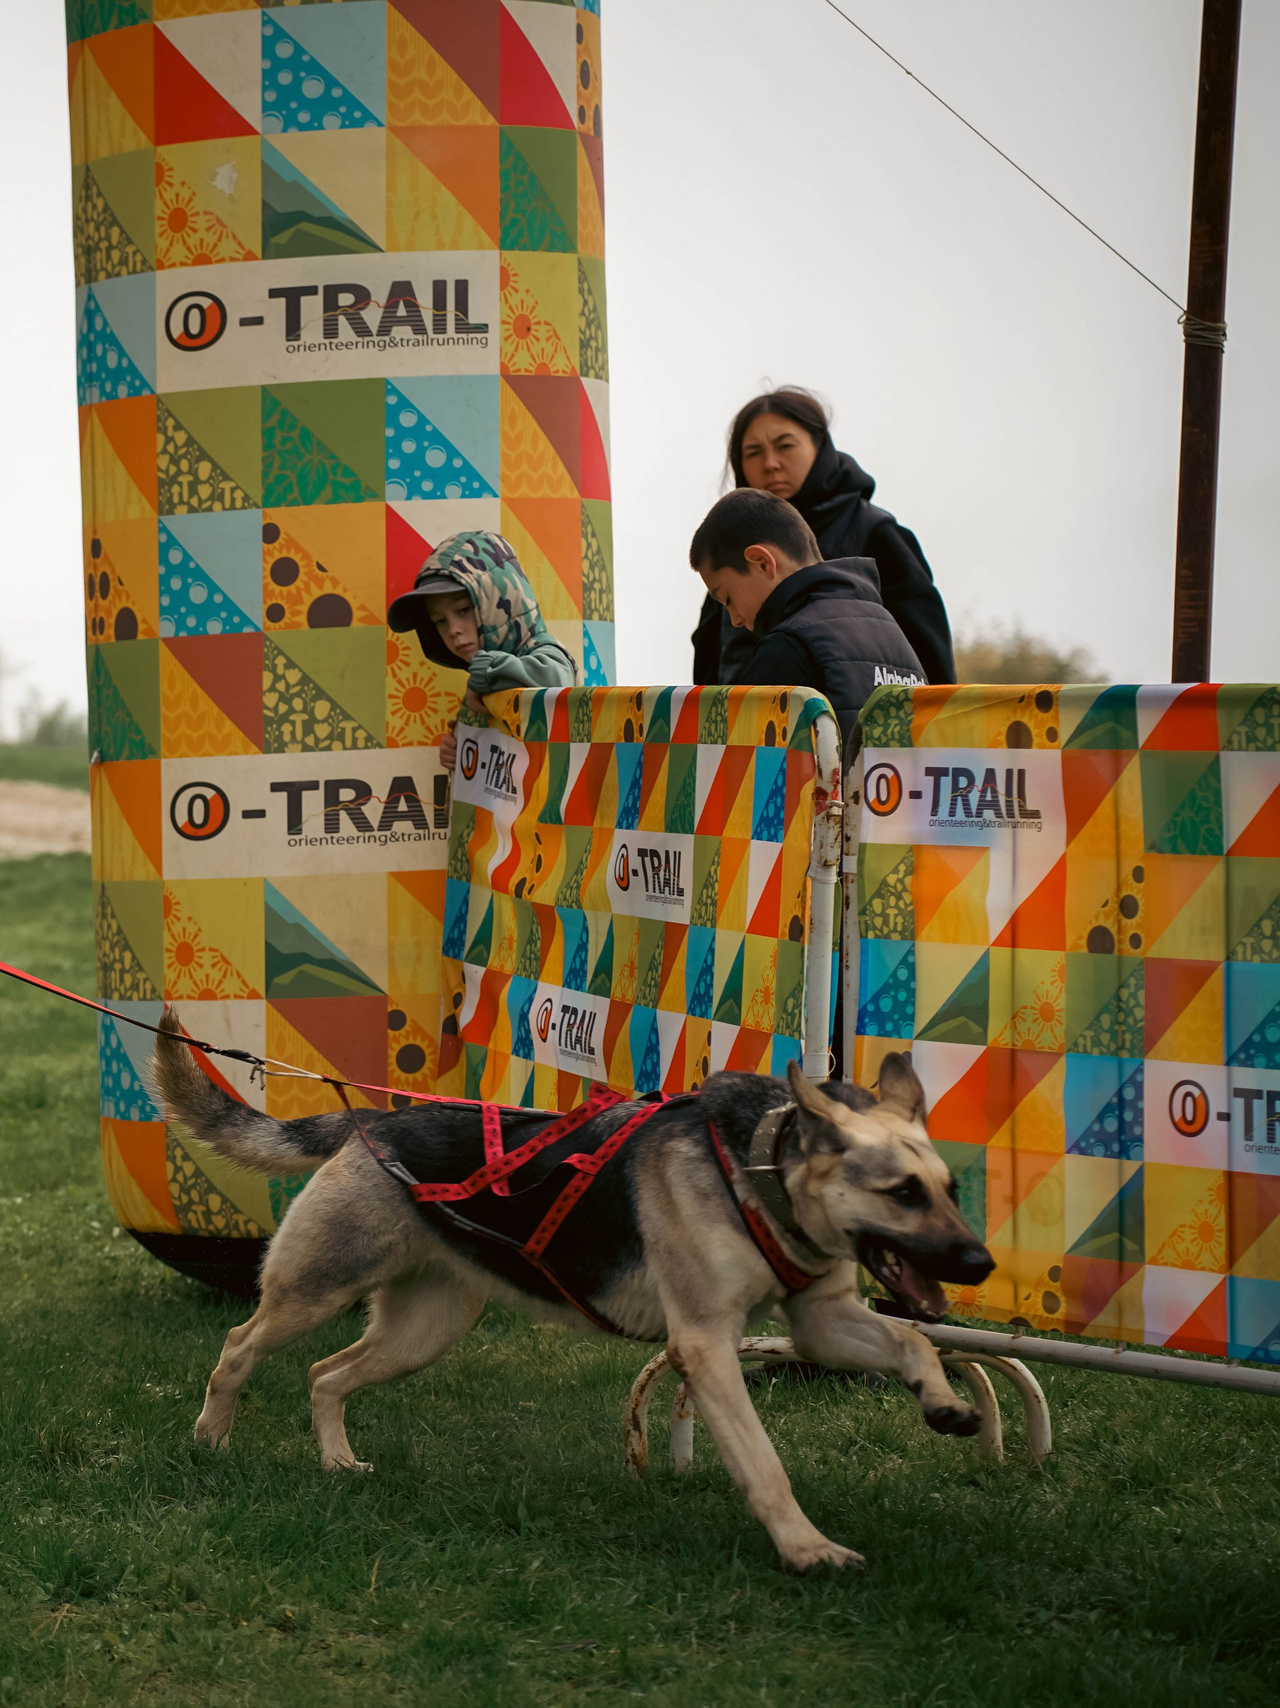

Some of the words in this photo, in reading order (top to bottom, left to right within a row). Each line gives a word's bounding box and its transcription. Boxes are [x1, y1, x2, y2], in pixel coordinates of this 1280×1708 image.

[286, 334, 489, 354] orienteering&trailrunning
[929, 817, 1042, 832] orienteering&trailrunning
[288, 828, 447, 847] orienteering&trailru
